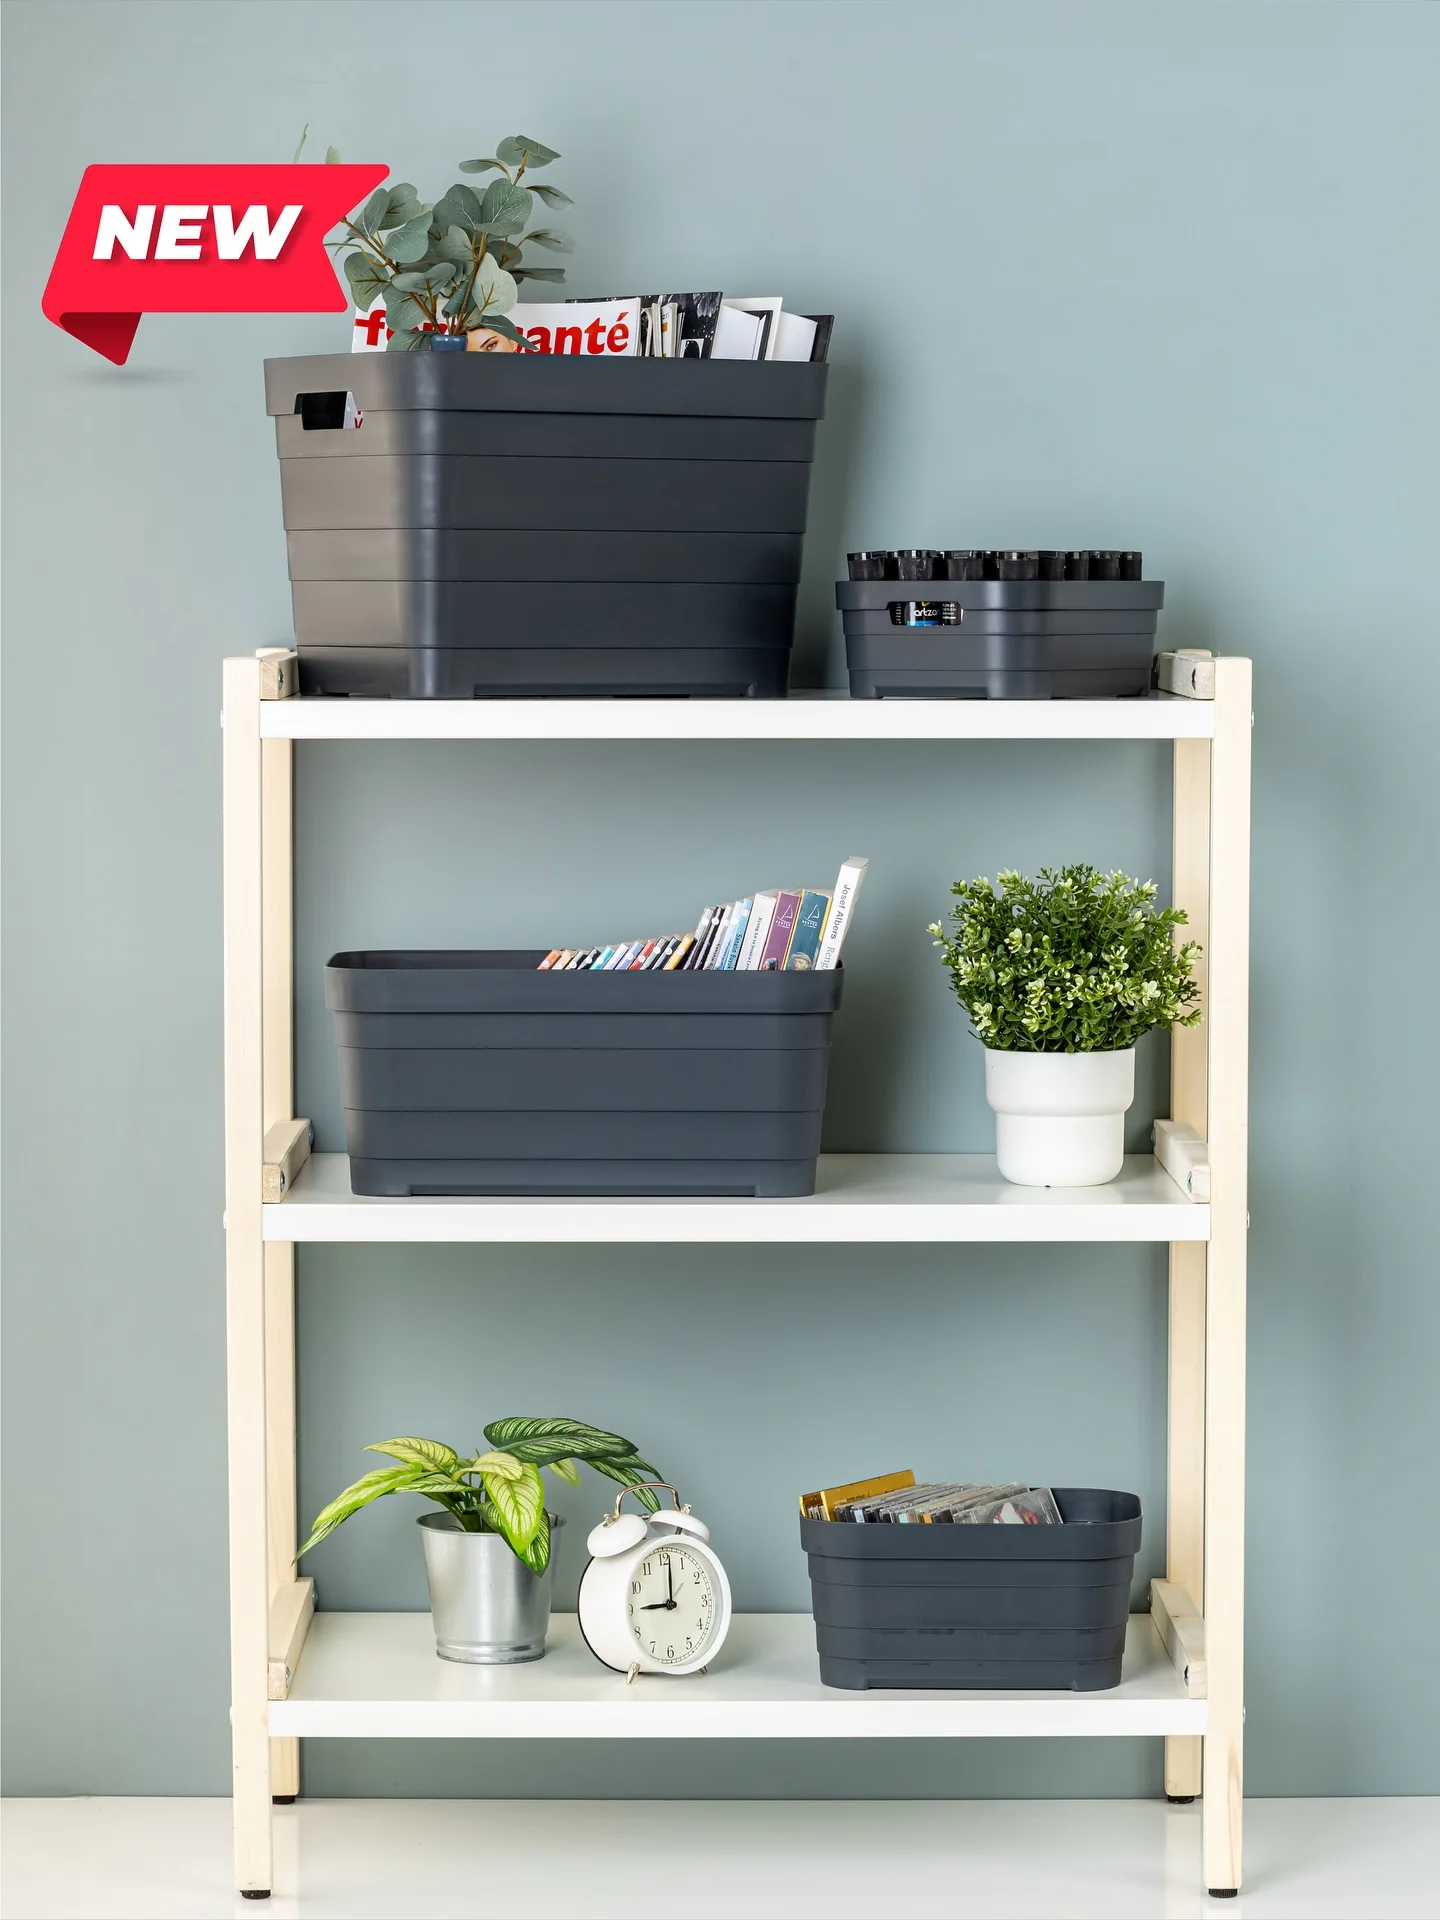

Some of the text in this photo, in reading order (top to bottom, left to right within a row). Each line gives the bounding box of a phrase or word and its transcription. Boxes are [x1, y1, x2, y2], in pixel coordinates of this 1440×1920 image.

[838, 884, 851, 910] Josef
[830, 910, 844, 940] Albers
[658, 1552, 670, 1566] 12
[680, 1557, 685, 1570] 1
[643, 1562, 652, 1576] 11
[693, 1571, 700, 1585] 2
[631, 1580, 642, 1595] 10
[701, 1594, 708, 1608] 3
[696, 1617, 703, 1631] 4
[634, 1625, 642, 1640] 8
[649, 1640, 656, 1654] 7
[685, 1636, 693, 1650] 5
[666, 1644, 675, 1659] 6
